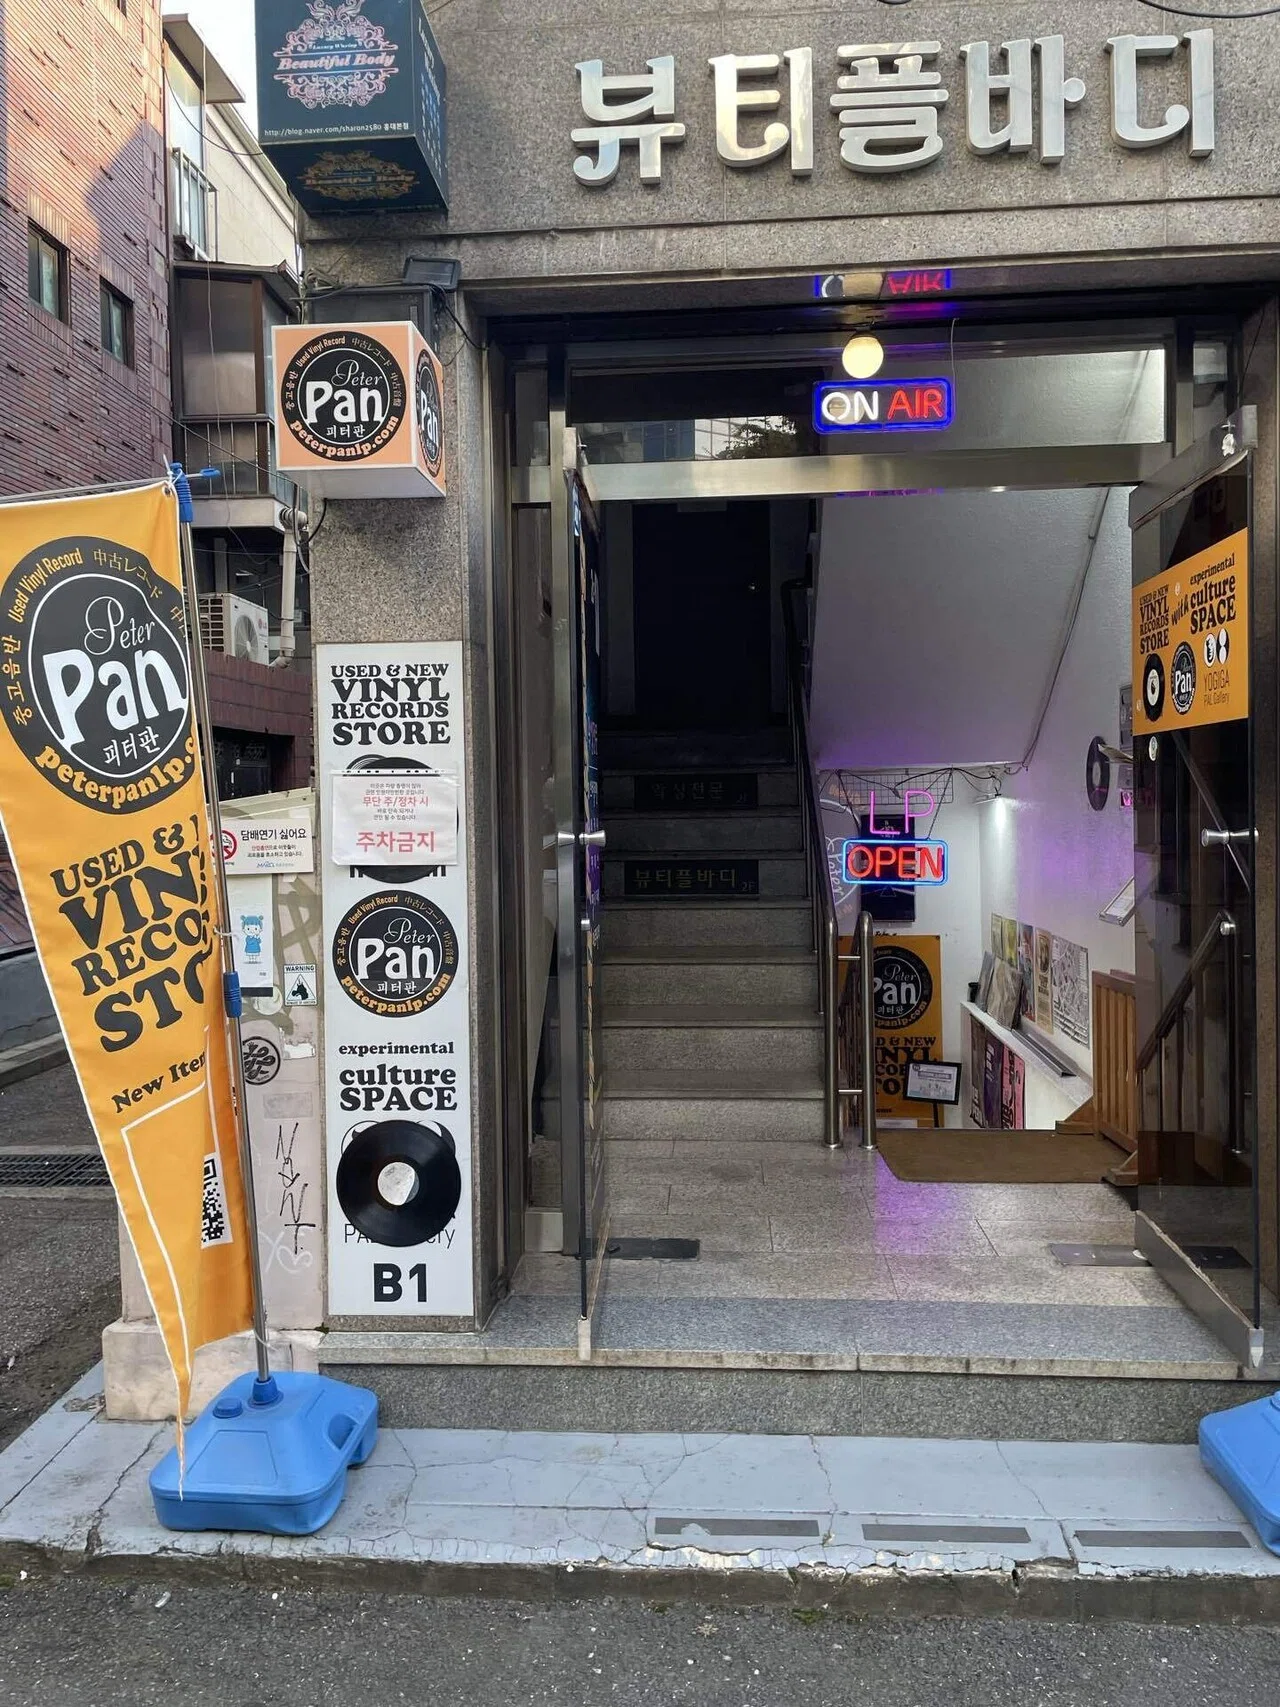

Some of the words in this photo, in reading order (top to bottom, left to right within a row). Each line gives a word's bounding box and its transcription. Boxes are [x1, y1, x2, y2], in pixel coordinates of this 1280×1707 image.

[277, 54, 351, 70] Beautiful
[352, 52, 395, 67] Body
[571, 28, 1215, 185] 뷰티플바디
[264, 123, 382, 137] http://blog.naver.com/sharon2580
[295, 350, 310, 368] Used
[308, 340, 323, 354] Vinyl
[322, 336, 346, 348] Record
[331, 359, 383, 387] Peter
[305, 381, 384, 424] Pan
[821, 390, 879, 421] ON
[887, 388, 943, 421] AIR
[290, 416, 399, 458] peterpanlp.com
[326, 424, 366, 439] 피터판
[93, 549, 163, 599] 中古レコード
[1189, 553, 1235, 585] experimental
[8, 587, 28, 624] Used
[18, 563, 48, 594] Vinyl
[42, 548, 84, 575] Record
[1139, 592, 1153, 606] USED
[1158, 584, 1169, 598] NEW
[1190, 574, 1236, 610] culture
[1139, 595, 1169, 623] VINYL
[1171, 594, 1189, 626] with
[1190, 593, 1236, 635] SPACE
[84, 596, 155, 655] Peter
[1139, 613, 1169, 637] RECORDS
[1139, 629, 1169, 655] STORE
[1, 635, 33, 726] 중고음반
[331, 664, 381, 678] USED
[386, 664, 401, 677] &
[405, 663, 449, 677] NEW
[1174, 669, 1193, 695] Pan
[1203, 669, 1230, 692] YOGIGA
[42, 649, 187, 742] Pan
[331, 677, 450, 702] VINYL
[331, 701, 449, 719] RECORDS
[103, 726, 160, 767] 피터판
[332, 721, 450, 746] STORE
[363, 797, 382, 807] 무단
[384, 797, 417, 807] 주/정차
[419, 797, 429, 807] 시
[869, 788, 935, 834] LP
[241, 829, 277, 842] 담배연기
[279, 828, 306, 841] 싫어요
[356, 831, 435, 853] 주차금지
[50, 839, 145, 898] USED
[153, 823, 184, 855] &
[847, 846, 944, 879] OPEN
[633, 869, 736, 889] 뷰티플바디
[347, 910, 362, 925] Used
[360, 899, 376, 913] Vinyl
[375, 894, 399, 905] Record
[383, 917, 435, 944] Peter
[357, 938, 437, 979] Pan
[883, 963, 917, 982] Peter
[341, 973, 451, 1014] peterpanlp.com
[377, 981, 417, 995] 피터판
[338, 1042, 454, 1057] experimental
[904, 1037, 937, 1047] NEW
[339, 1064, 456, 1085] culture
[111, 1075, 165, 1113] New
[339, 1086, 457, 1111] SPACE
[373, 1263, 427, 1303] B1
